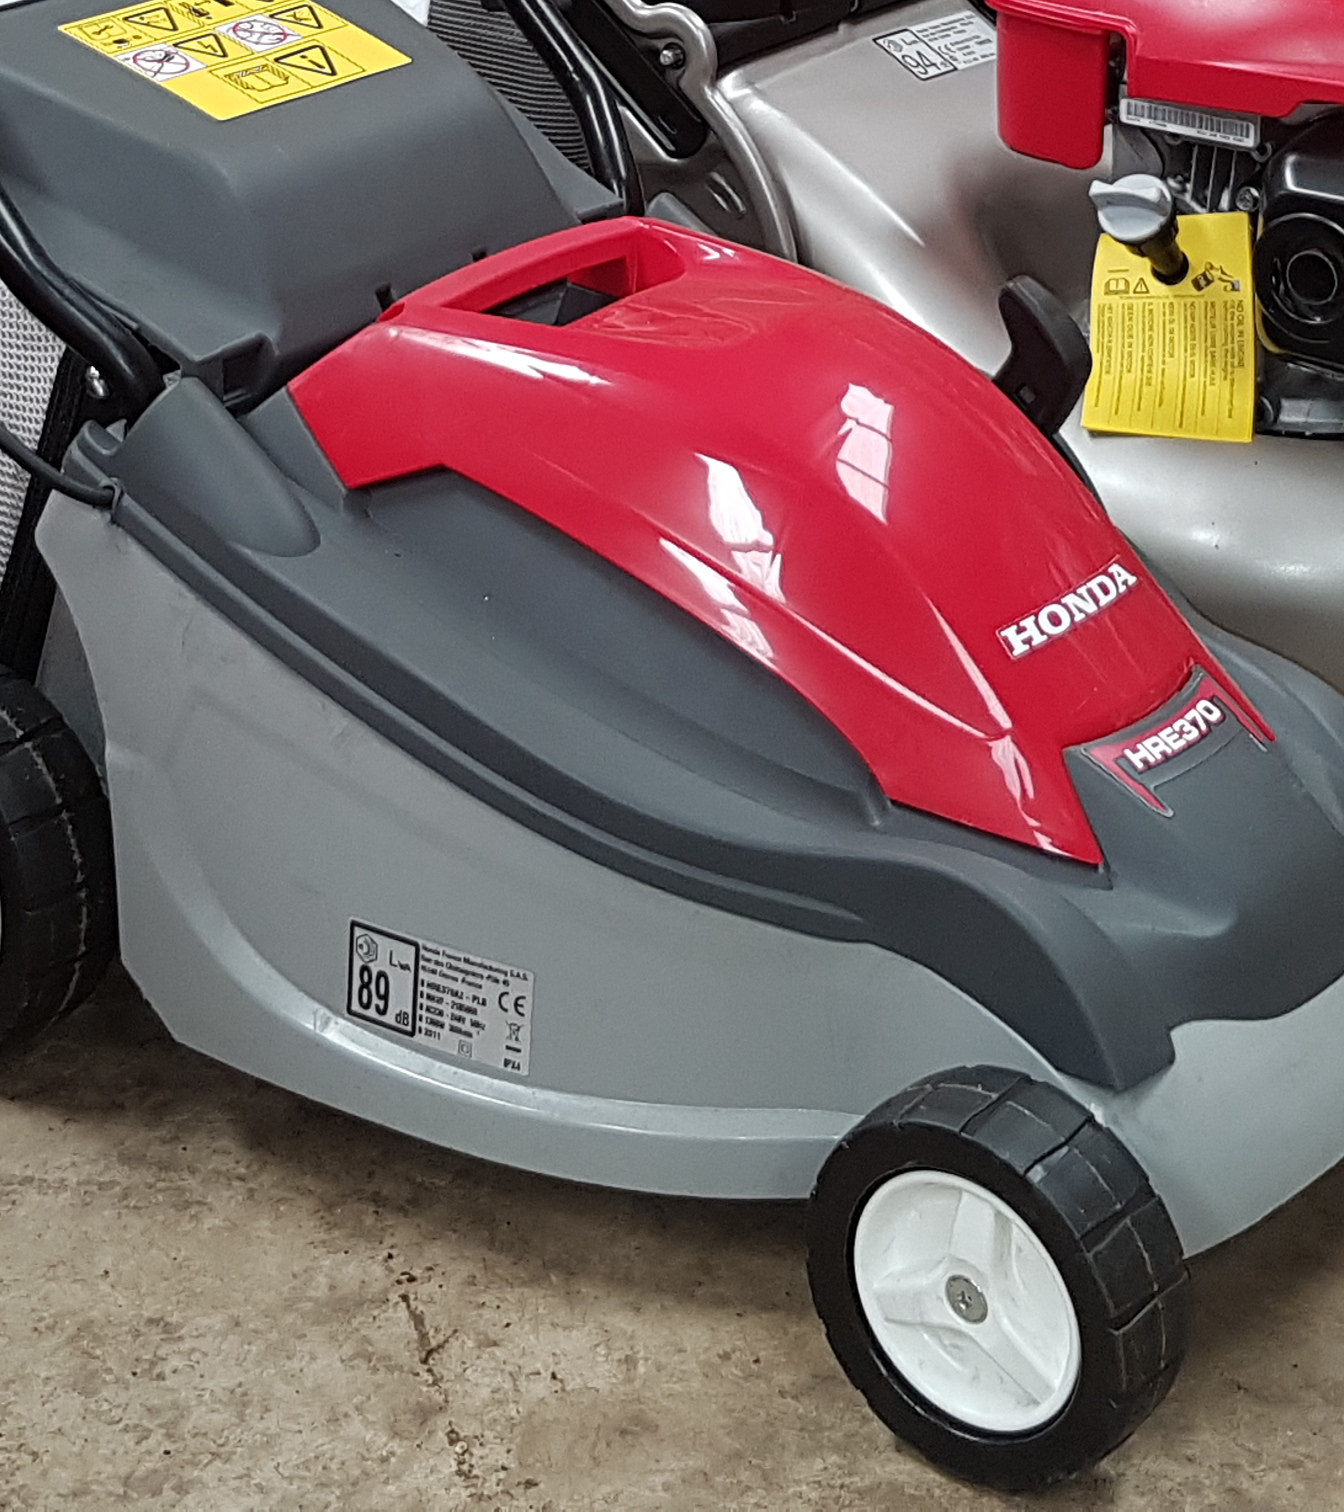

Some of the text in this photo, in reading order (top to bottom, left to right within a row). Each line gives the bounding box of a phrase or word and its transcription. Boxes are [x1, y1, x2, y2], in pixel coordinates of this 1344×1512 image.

[902, 50, 942, 75] 94
[1000, 563, 1137, 657] HONDA
[1123, 699, 1222, 771] HRE370
[358, 964, 390, 1016] 89
[395, 1009, 410, 1026] dB
